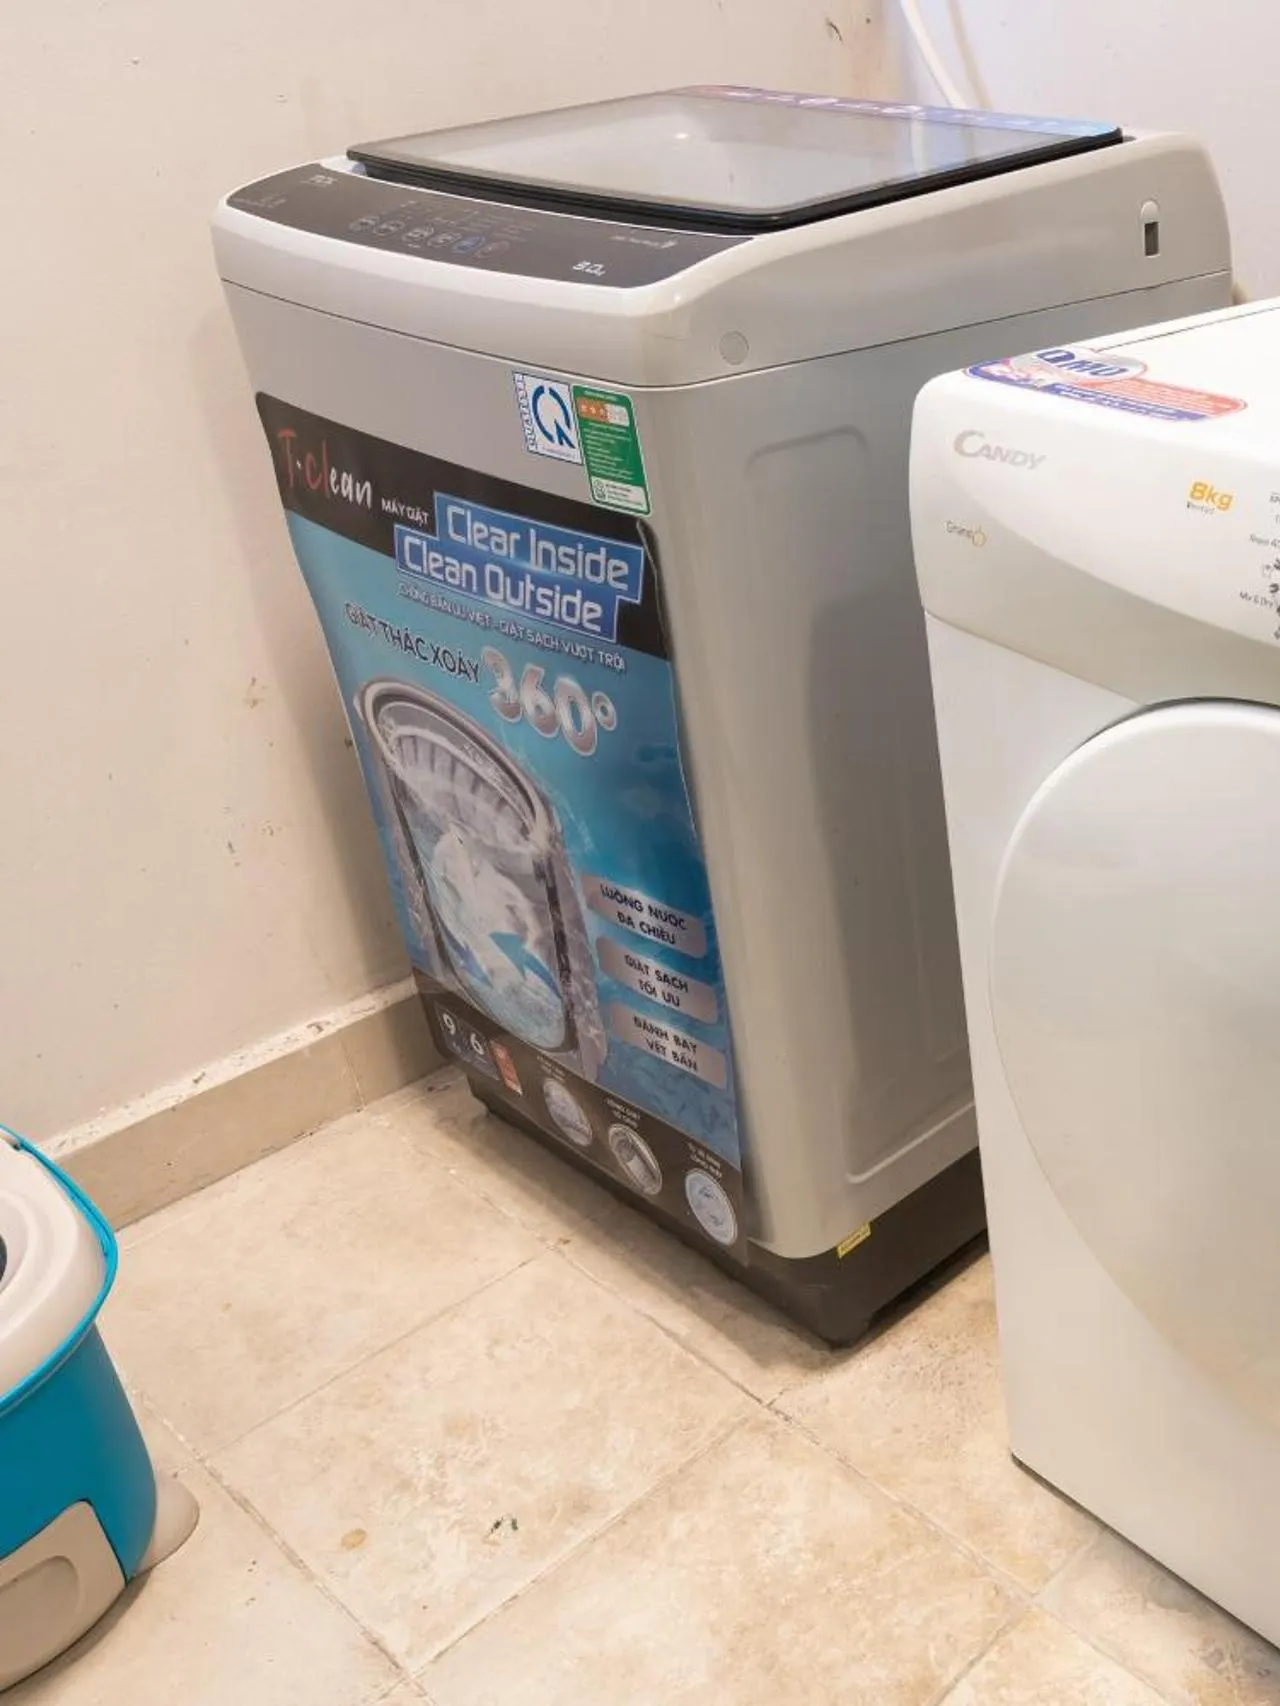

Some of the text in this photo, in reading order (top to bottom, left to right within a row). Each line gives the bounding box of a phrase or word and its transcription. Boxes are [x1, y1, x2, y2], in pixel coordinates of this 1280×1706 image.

[952, 429, 1047, 470] CANDY
[1190, 481, 1234, 512] 8kg
[446, 506, 630, 592] Clear Inside
[403, 536, 604, 632] Clean Outside
